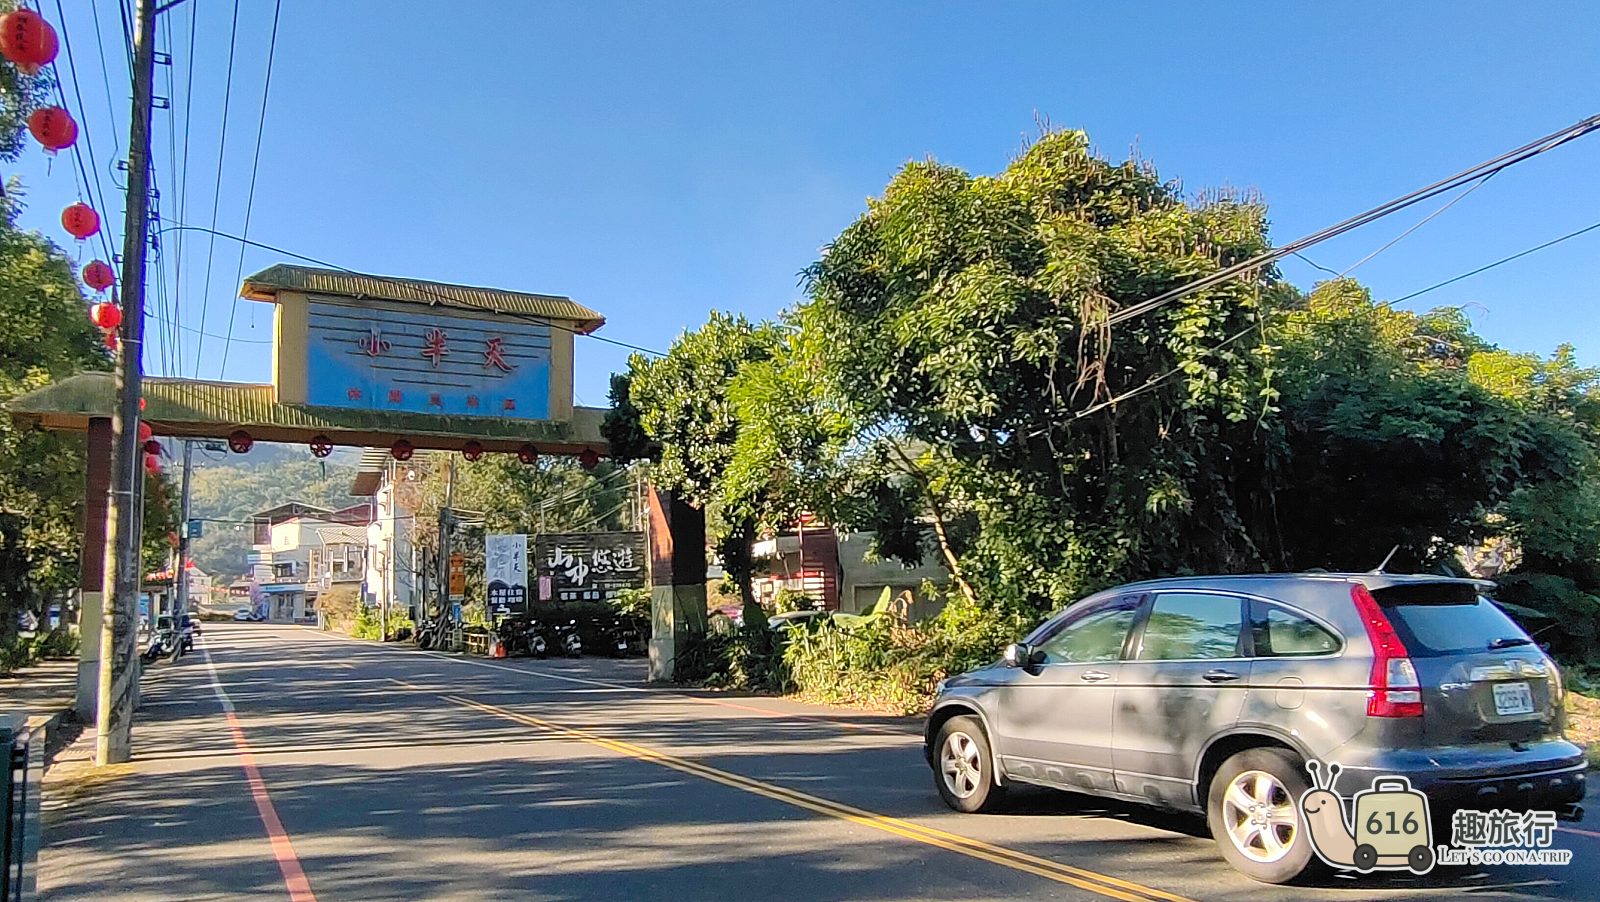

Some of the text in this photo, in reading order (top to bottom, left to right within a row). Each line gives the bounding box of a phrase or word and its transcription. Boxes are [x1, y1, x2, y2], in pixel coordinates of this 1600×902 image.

[358, 327, 513, 373] 小半天
[512, 541, 522, 573] 小半天
